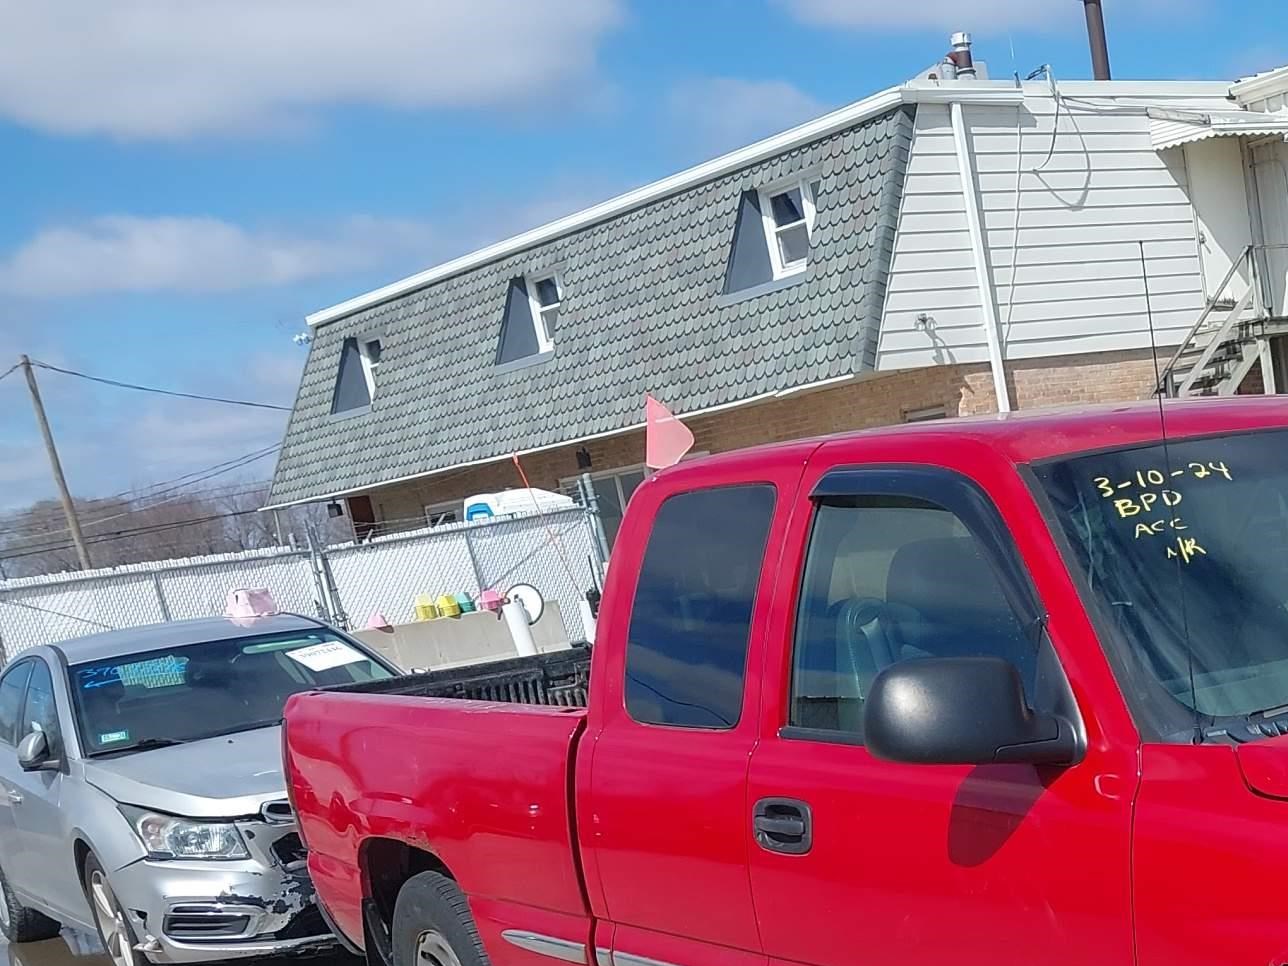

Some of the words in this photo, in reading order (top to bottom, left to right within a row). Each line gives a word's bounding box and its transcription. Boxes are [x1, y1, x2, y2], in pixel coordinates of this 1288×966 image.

[1094, 461, 1233, 498] 3-10-24
[1113, 489, 1183, 518] BPD
[1134, 518, 1189, 539] ACC
